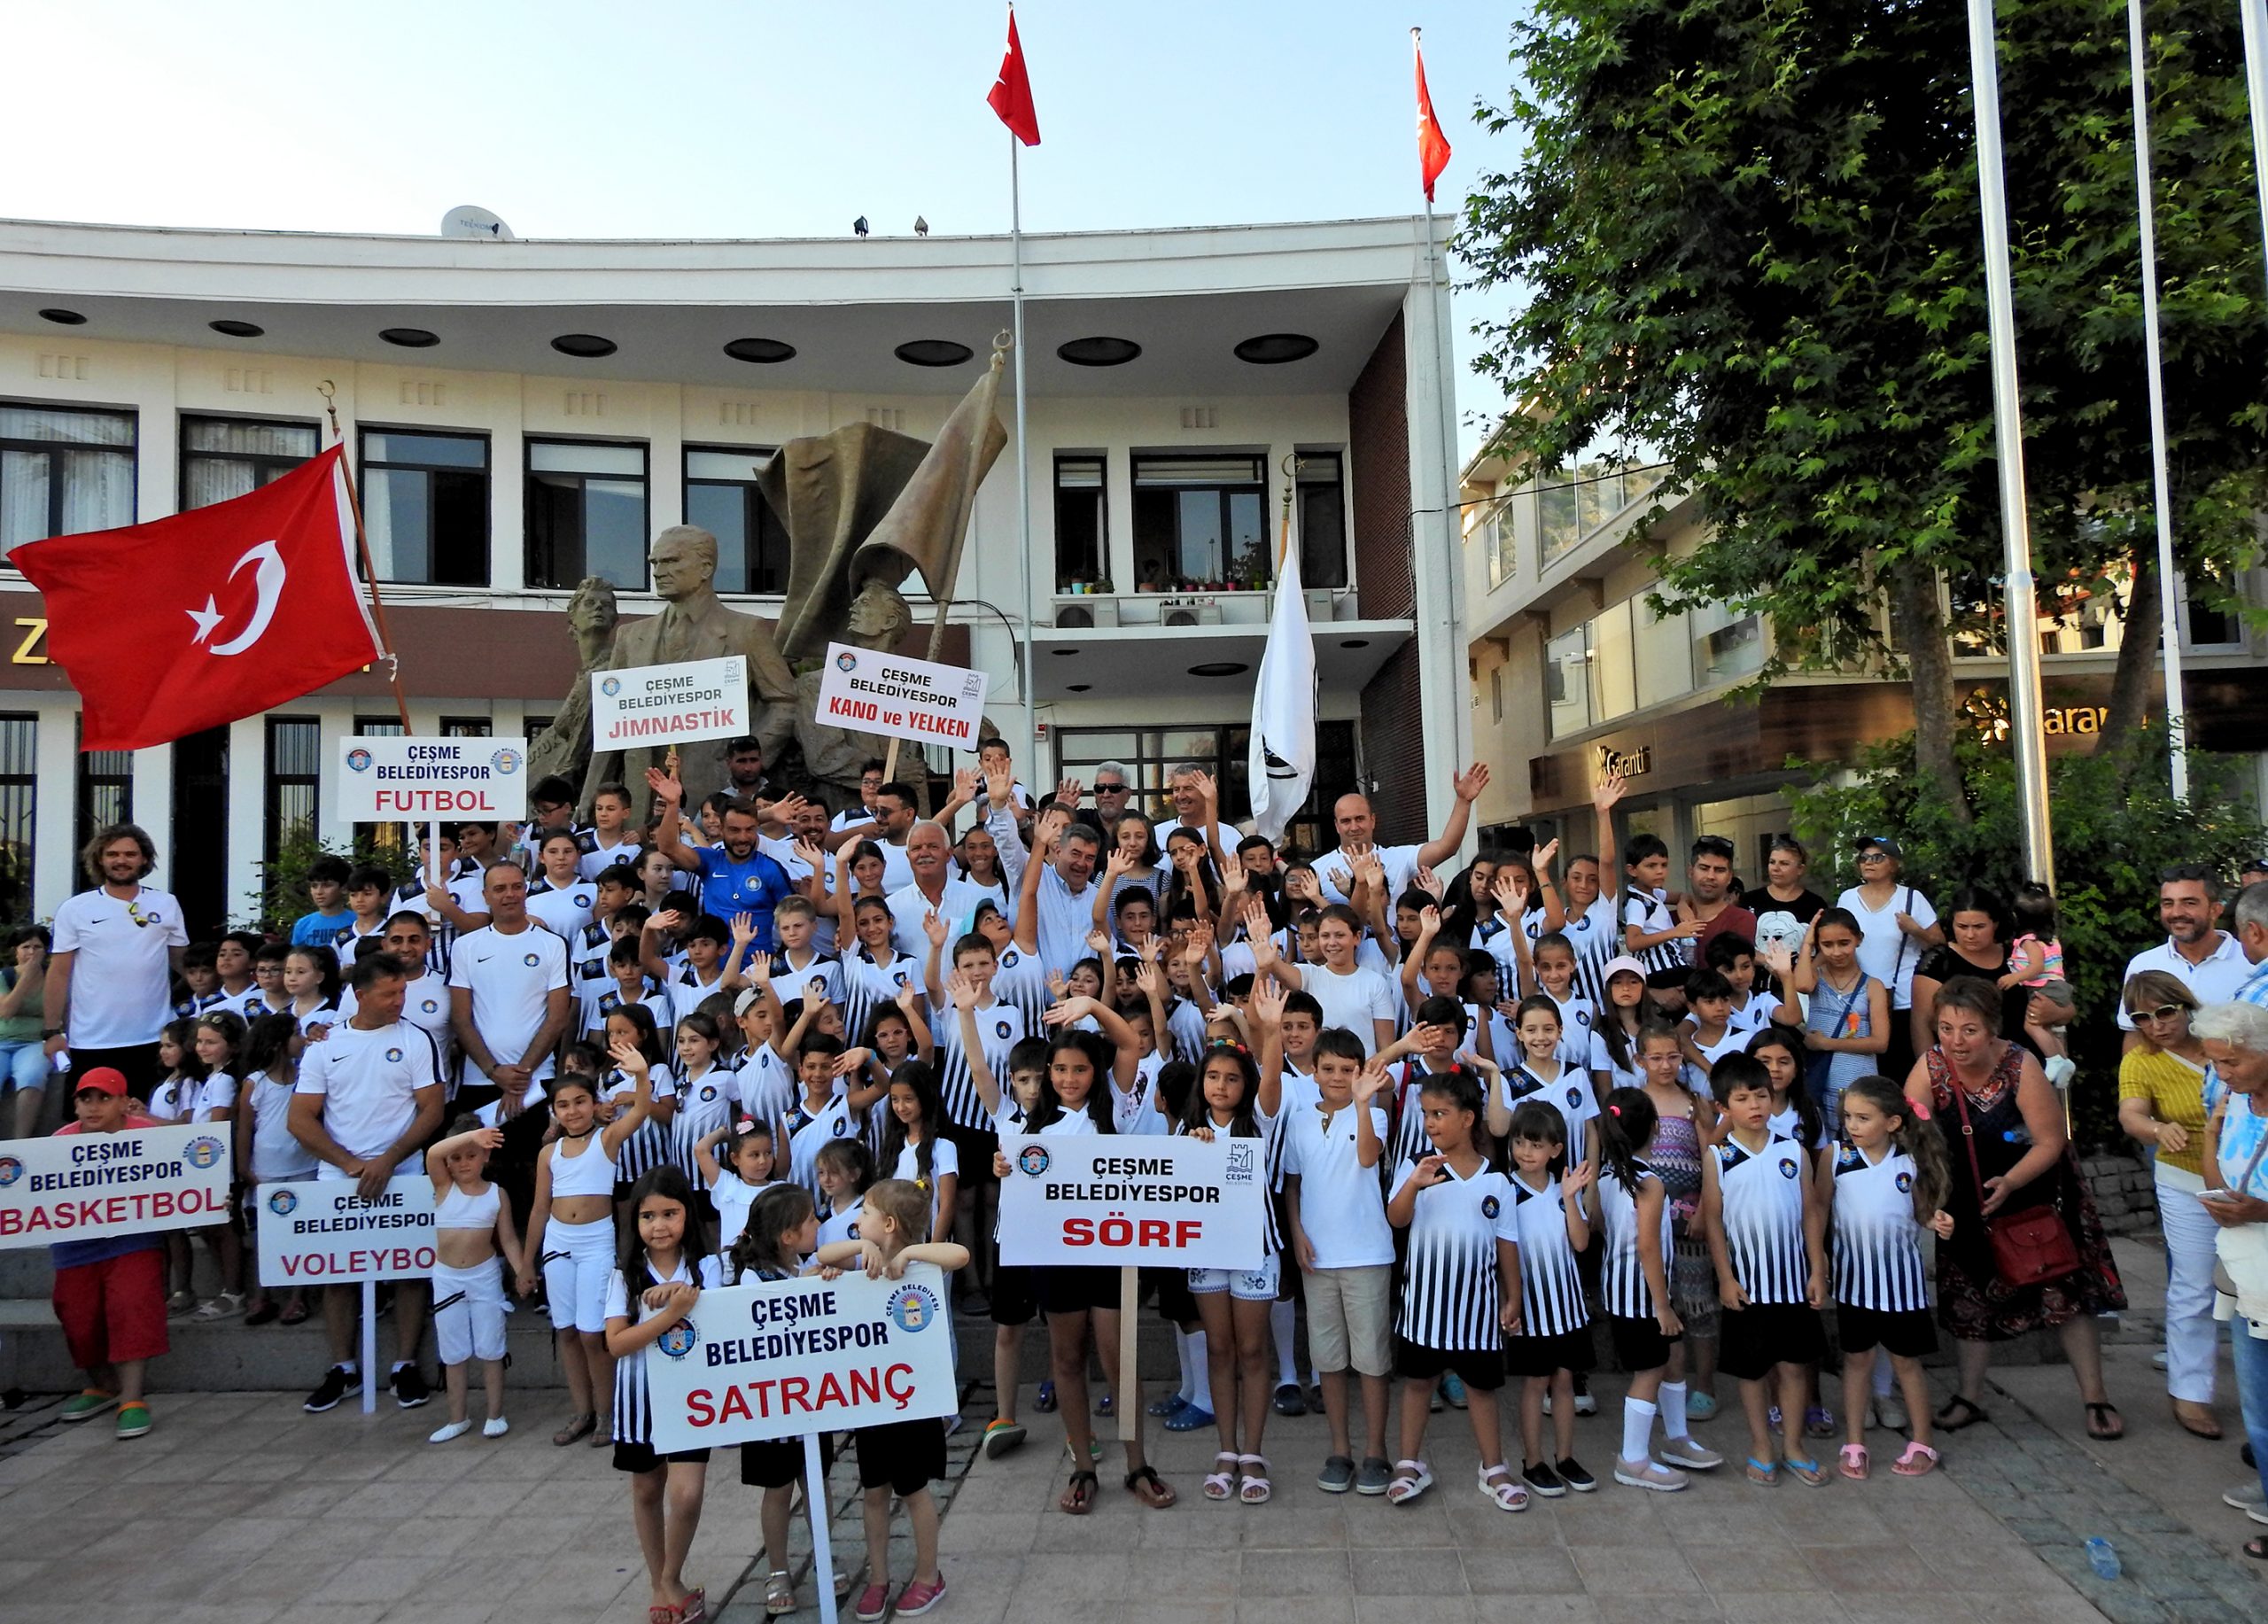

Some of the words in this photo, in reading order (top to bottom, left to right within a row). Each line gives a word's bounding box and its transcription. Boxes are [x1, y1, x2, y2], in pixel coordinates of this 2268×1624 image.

[646, 676, 694, 694] ÇEŞME
[882, 668, 932, 687] ÇEŞME
[618, 688, 722, 710] BELEDİYESPOR
[850, 678, 958, 708] BELEDİYESPOR
[609, 706, 735, 739] JİMNASTİK
[829, 696, 878, 721] KANO
[883, 711, 902, 726] ve
[909, 711, 970, 738] YELKEN
[408, 746, 461, 763] ÇEŞME
[1606, 746, 1644, 777] Garanti
[377, 763, 490, 780] BELEDİYESPOR
[376, 790, 495, 811] FUTBOL
[72, 1139, 144, 1167] ÇEŞME
[30, 1161, 183, 1193] BELEDİYESPOR
[1092, 1158, 1174, 1179] ÇEŞME
[334, 1193, 403, 1214] ÇEŞME
[1045, 1179, 1220, 1203] BELEDİYESPOR
[0, 1187, 225, 1236] BASKETBOL
[1062, 1211, 1202, 1248] SÖRF
[281, 1247, 436, 1277] VOLEYBO
[751, 1291, 837, 1330] ÇEŞME
[706, 1321, 889, 1367] BELEDİYESPOR
[686, 1363, 916, 1428] SATRANÇ
